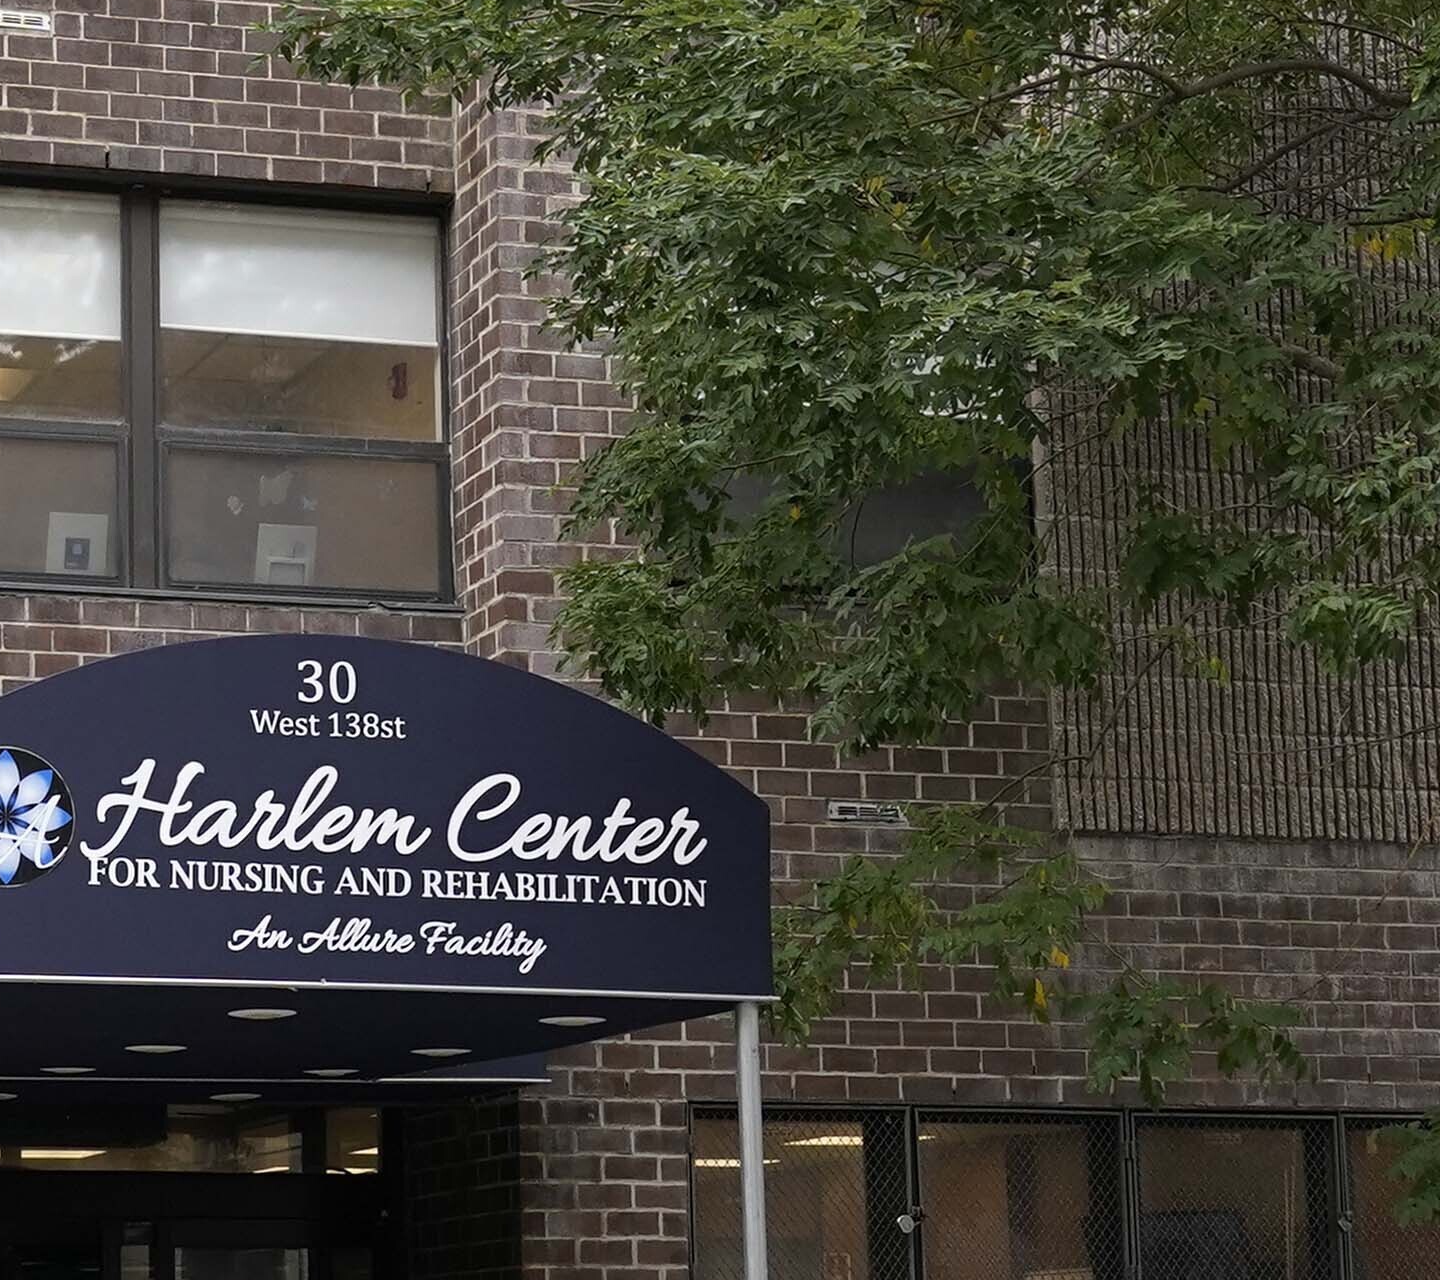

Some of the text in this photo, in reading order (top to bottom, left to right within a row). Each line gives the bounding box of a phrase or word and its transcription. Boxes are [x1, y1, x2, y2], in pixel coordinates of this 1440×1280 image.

[296, 659, 358, 705] 30
[250, 709, 406, 739] West 138st
[80, 758, 707, 866] Harlem Center
[87, 856, 707, 908] FOR NURSING AND REHABILITATION
[227, 914, 547, 974] An Allure Facility
